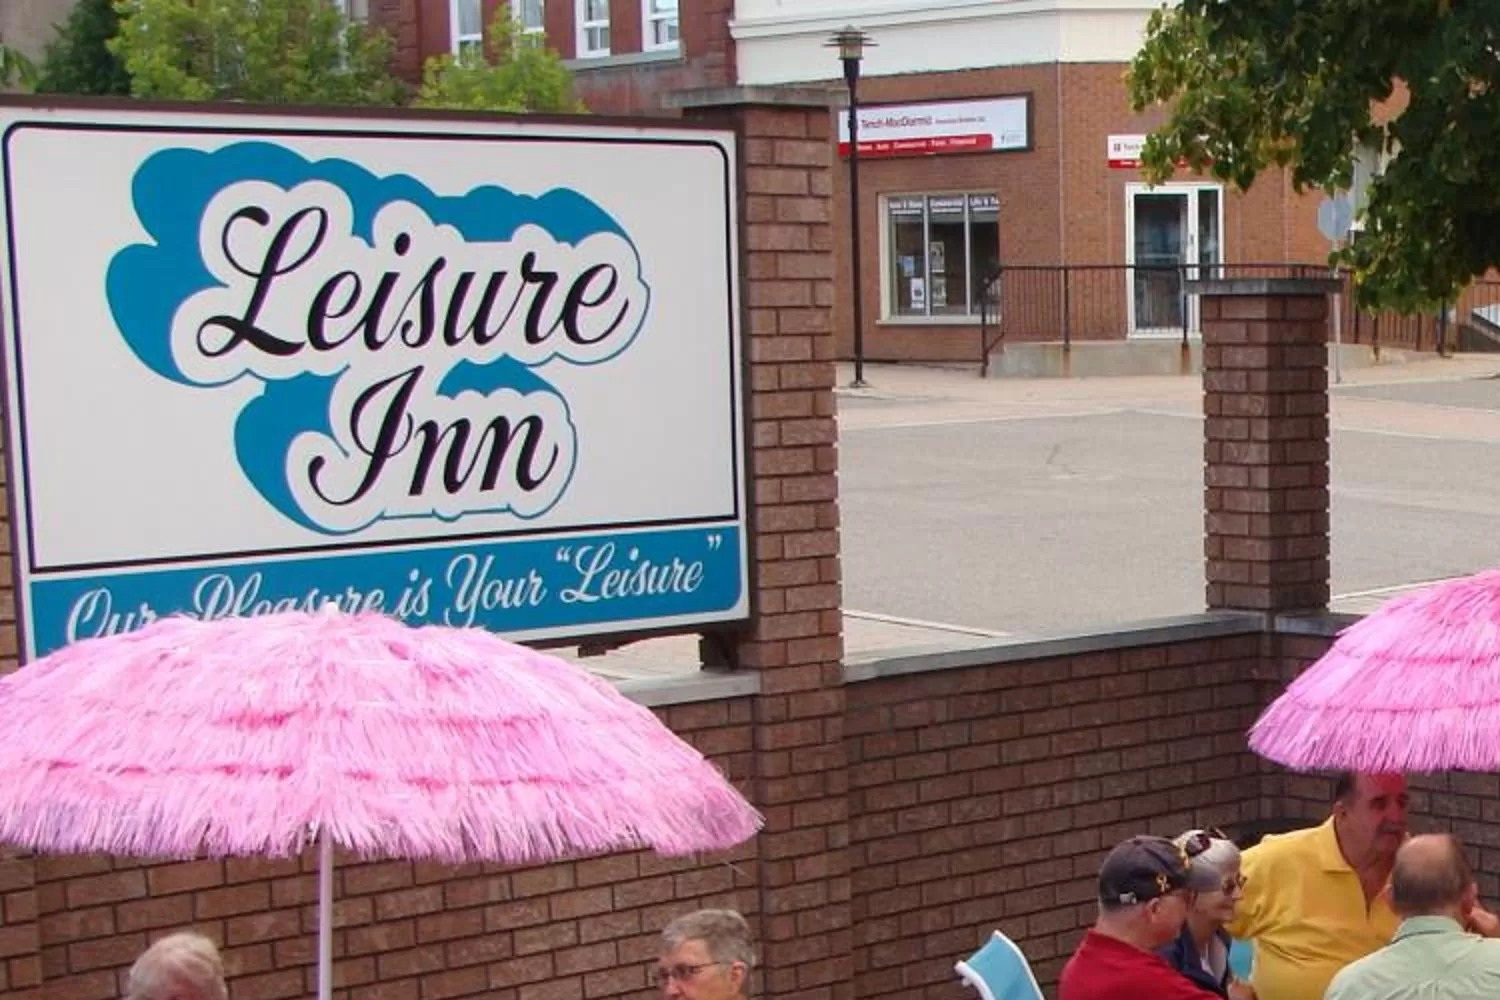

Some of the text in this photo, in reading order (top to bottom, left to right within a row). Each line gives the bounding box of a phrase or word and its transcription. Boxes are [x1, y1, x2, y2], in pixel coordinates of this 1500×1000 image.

[197, 206, 629, 357] Leisure
[309, 364, 558, 505] Inn
[67, 587, 157, 644] Our
[393, 568, 433, 617] is
[444, 553, 548, 628] Your
